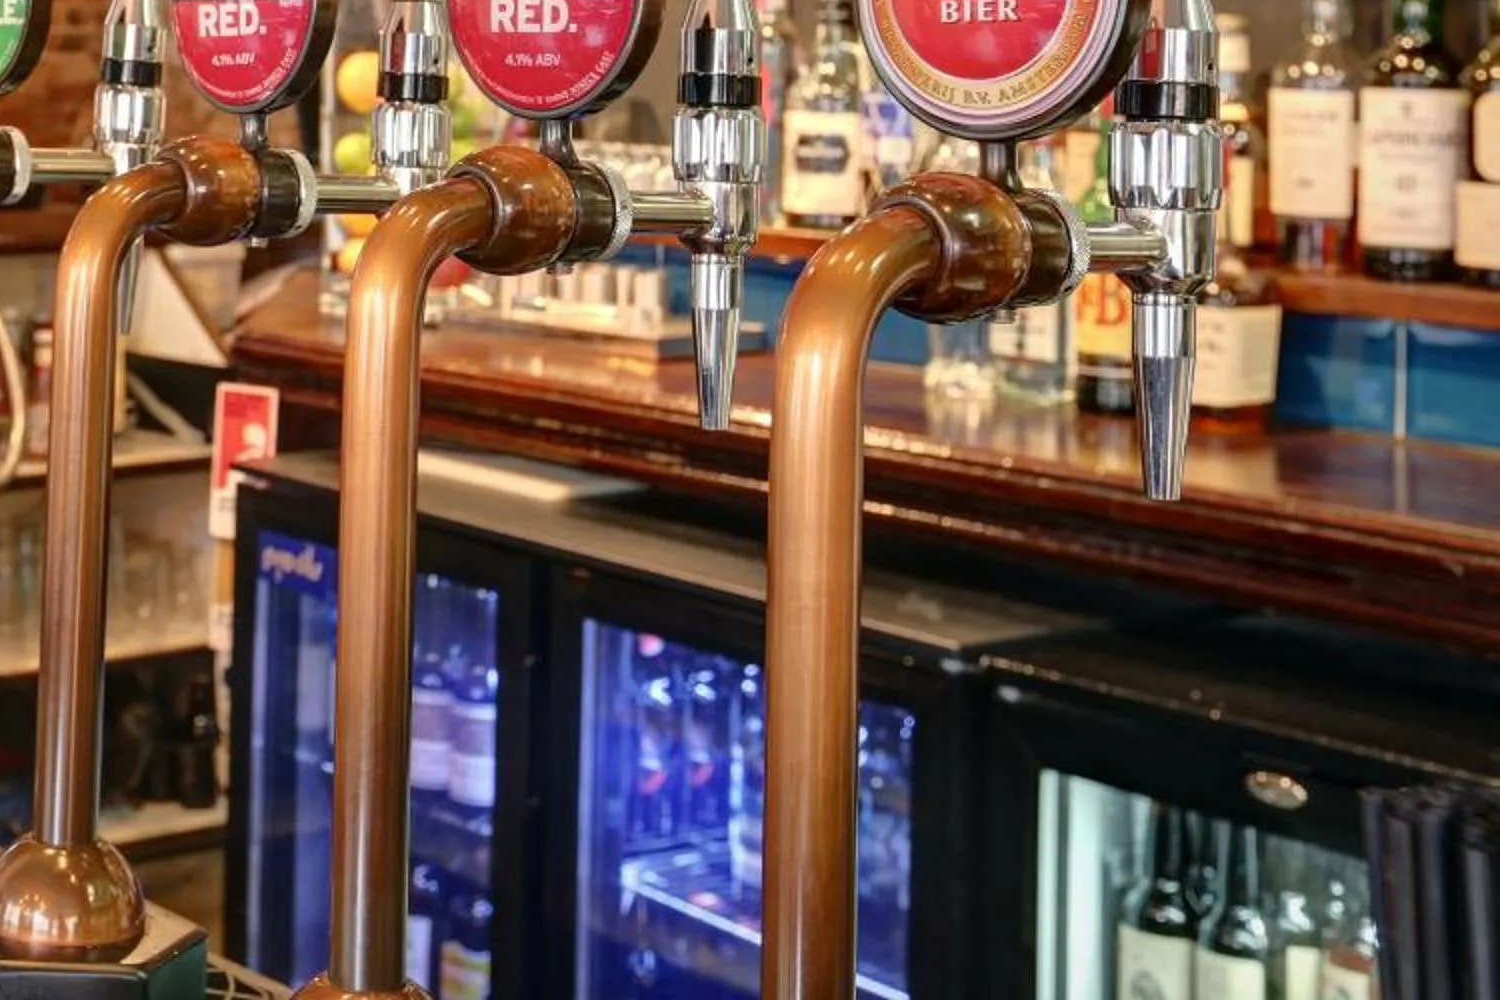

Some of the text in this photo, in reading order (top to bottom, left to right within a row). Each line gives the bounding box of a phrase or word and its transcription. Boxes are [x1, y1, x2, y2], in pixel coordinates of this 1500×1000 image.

[198, 3, 267, 38] RED.
[505, 52, 562, 68] 4.1% ABV
